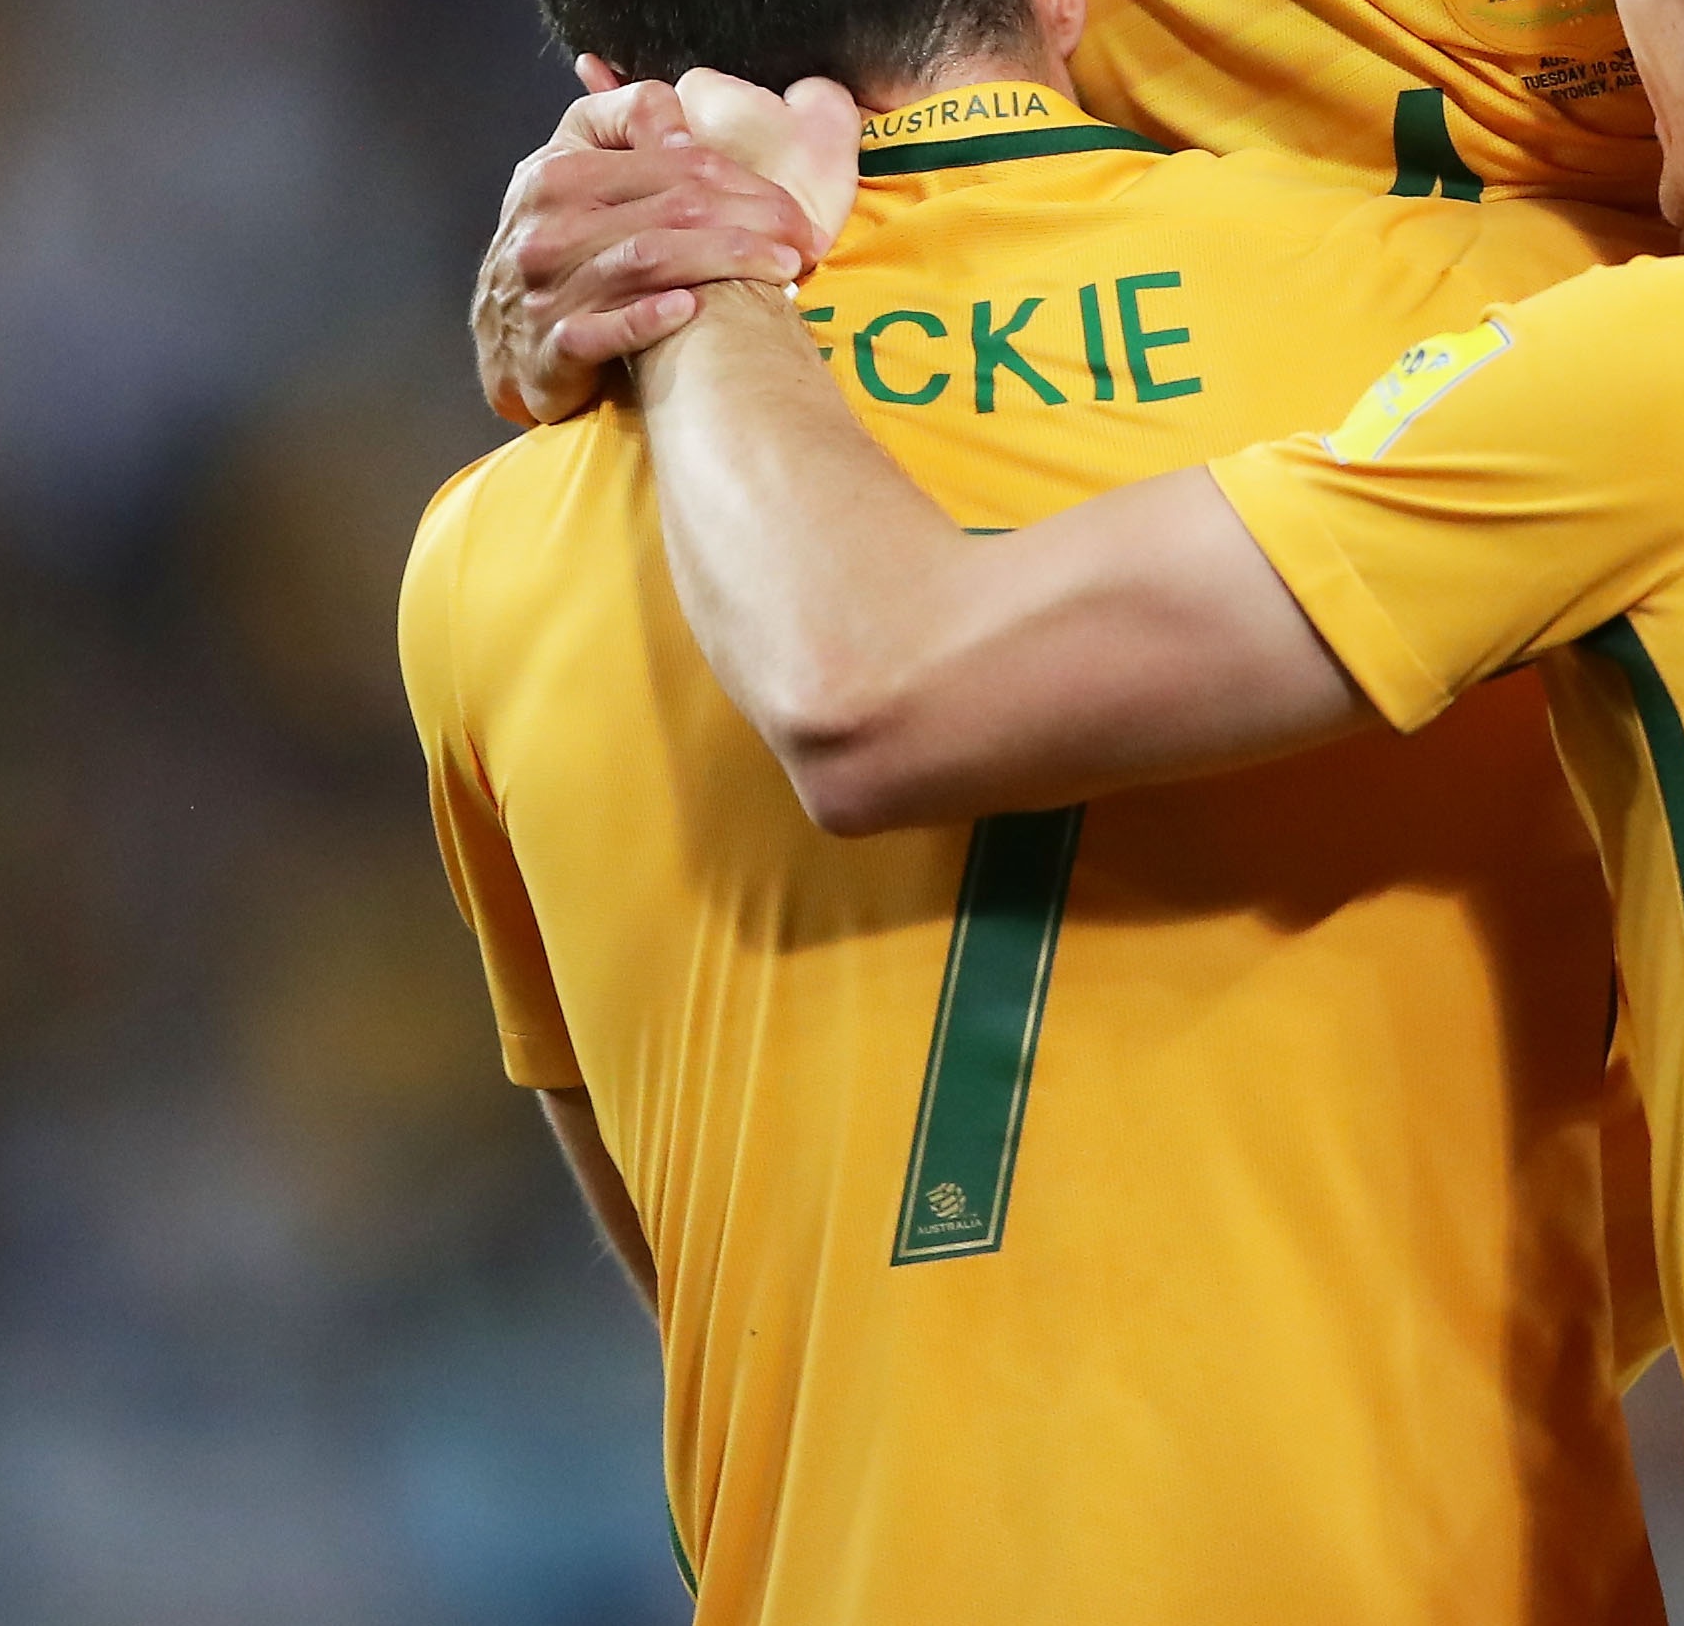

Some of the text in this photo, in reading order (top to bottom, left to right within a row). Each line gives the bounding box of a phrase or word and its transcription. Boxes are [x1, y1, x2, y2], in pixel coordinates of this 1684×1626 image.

[1521, 65, 1586, 90] TUESDAY
[1591, 60, 1607, 76] 10
[860, 91, 1050, 140] AUSTRALIA
[917, 1218, 983, 1235] AUSTRALIA
